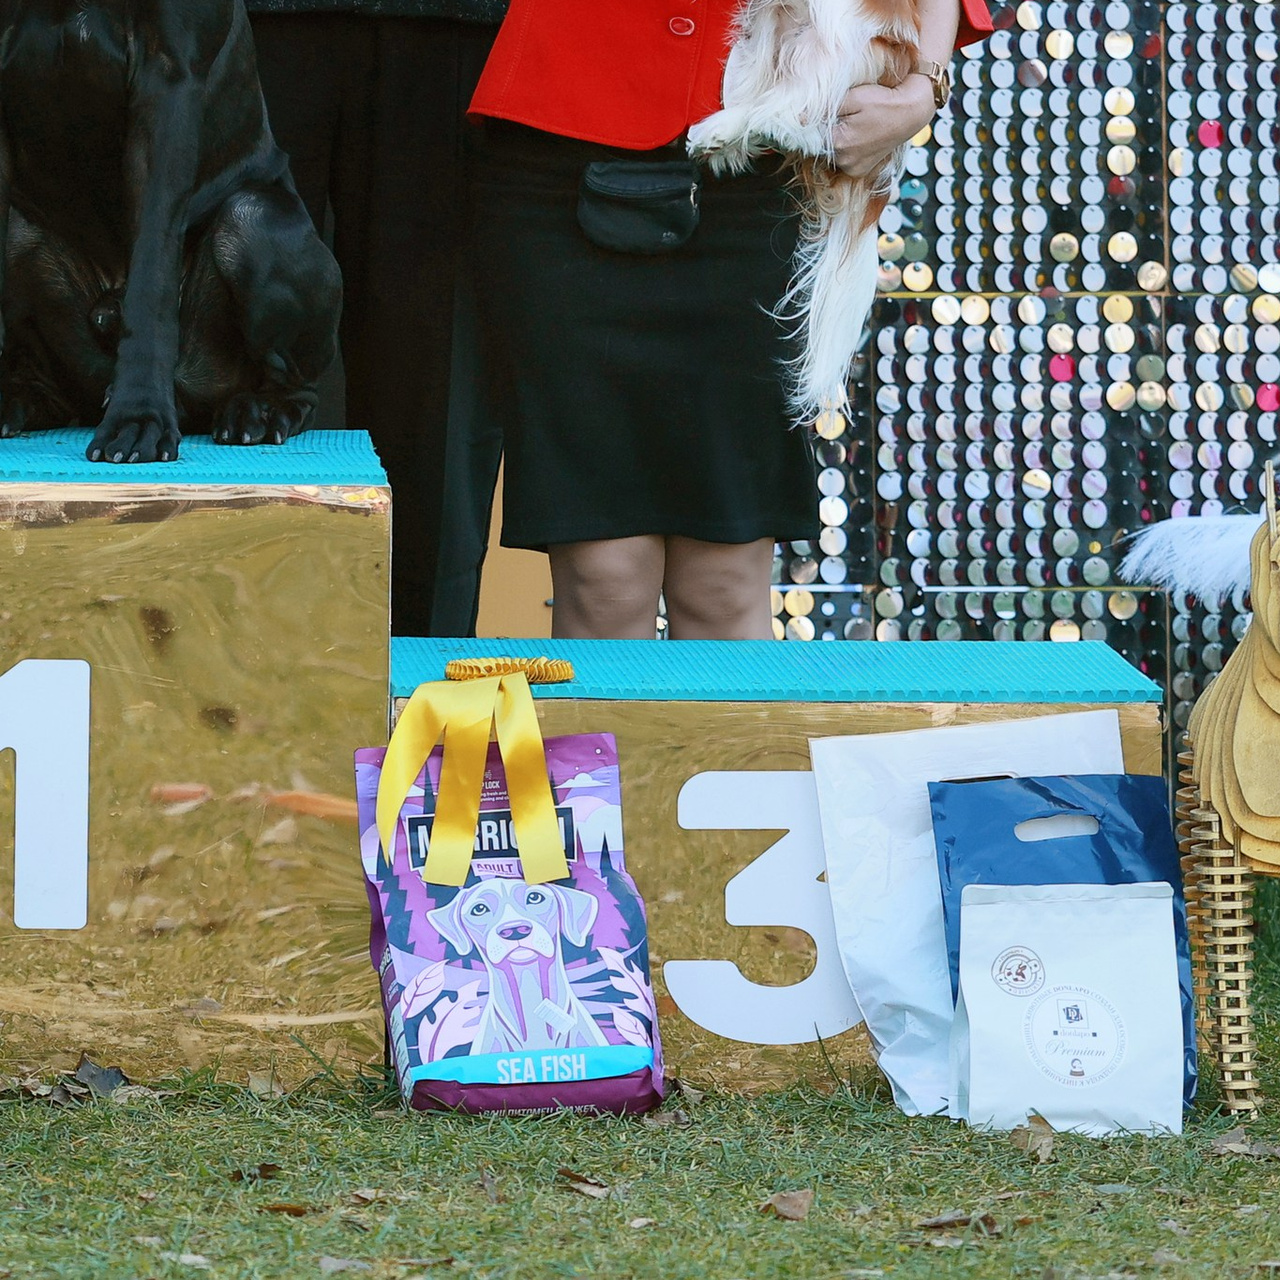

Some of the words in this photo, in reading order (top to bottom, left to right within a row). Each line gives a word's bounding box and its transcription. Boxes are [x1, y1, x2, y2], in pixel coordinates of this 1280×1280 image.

[485, 780, 501, 789] LOCK
[477, 863, 513, 873] ADULT
[663, 770, 863, 1045] 3
[1053, 985, 1090, 995] DONLAPO
[1045, 1039, 1107, 1057] Premium
[497, 1057, 538, 1084] SEA
[541, 1053, 587, 1081] FISH
[555, 1104, 596, 1114] САЖЕТ
